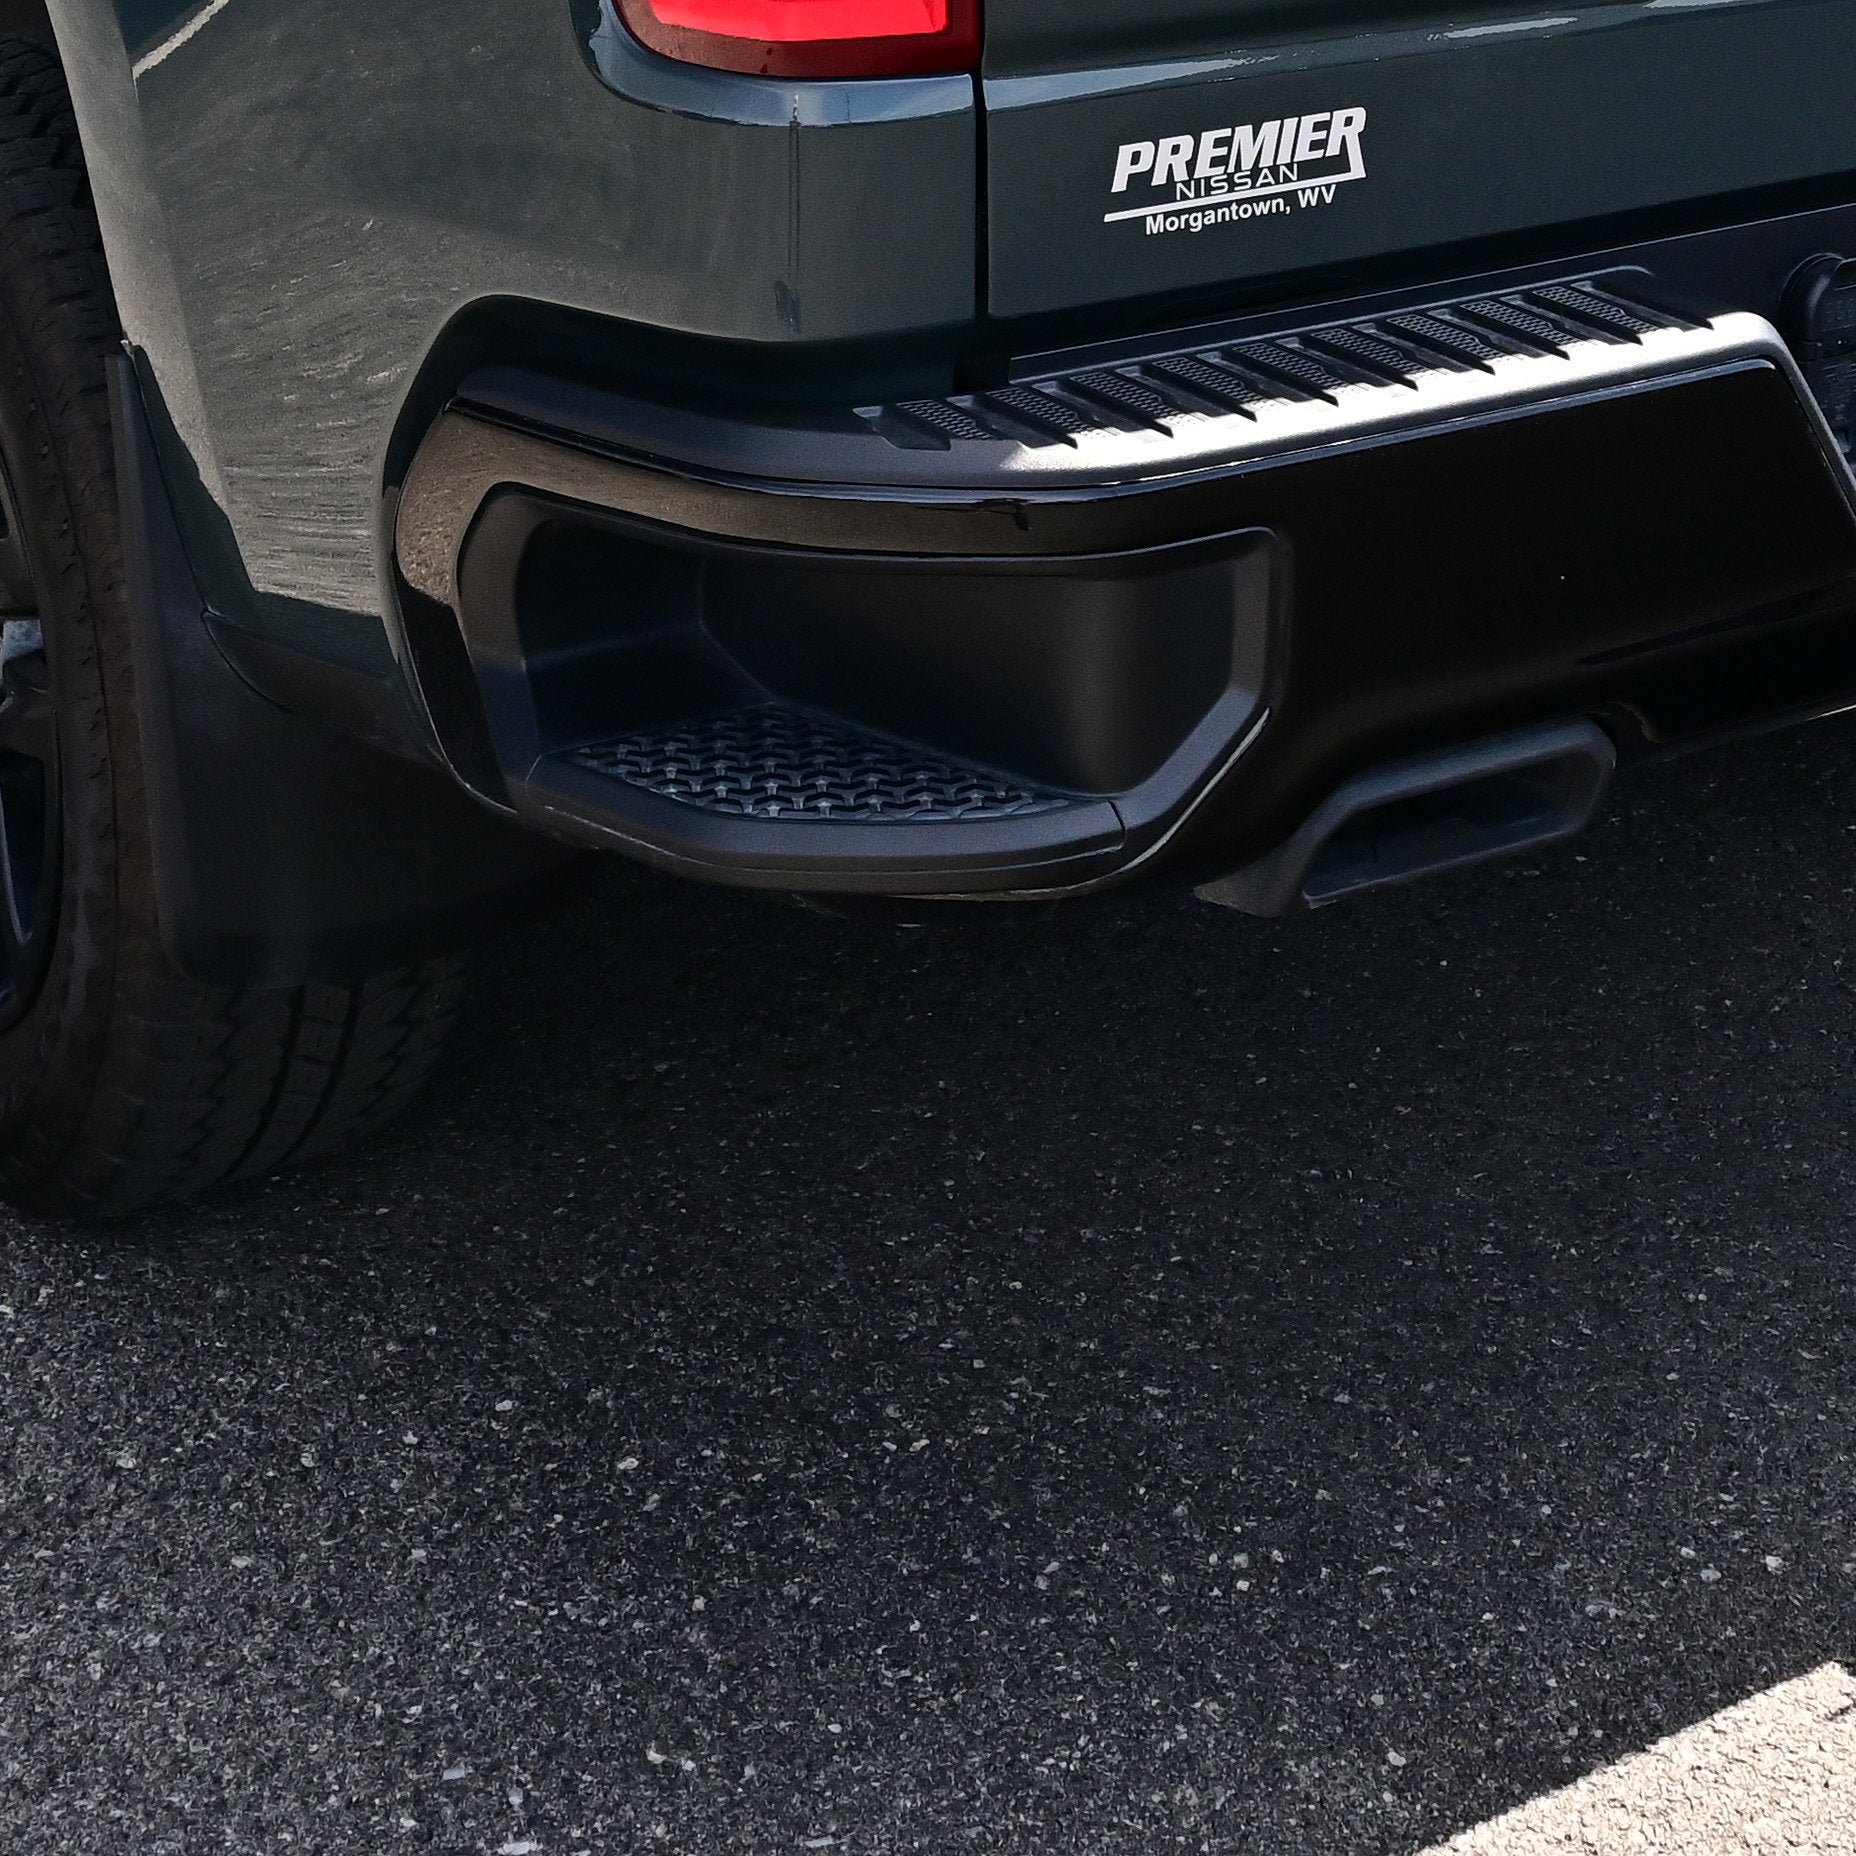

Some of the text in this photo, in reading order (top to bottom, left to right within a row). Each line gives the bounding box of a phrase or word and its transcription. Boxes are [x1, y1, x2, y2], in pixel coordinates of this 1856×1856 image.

[1111, 106, 1367, 193] PREMIER
[1175, 163, 1299, 201] NISSAN
[1145, 184, 1337, 236] Morgantown, WV
